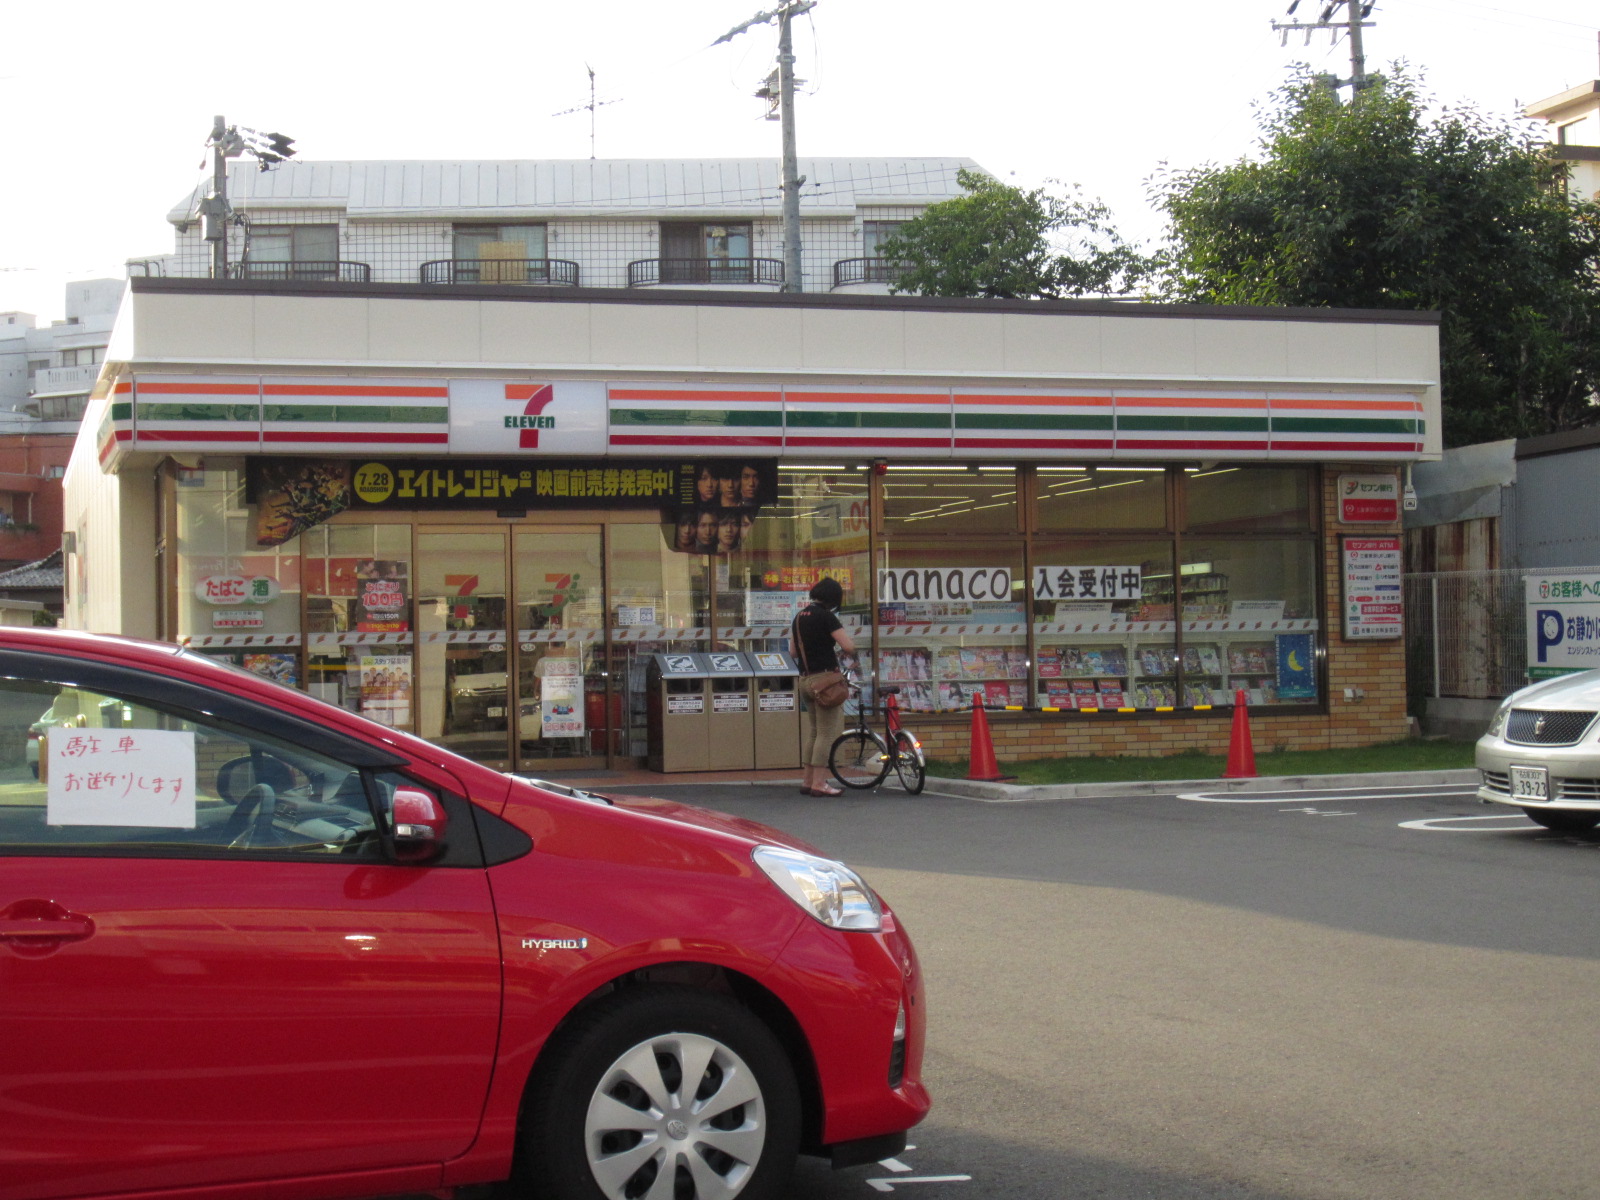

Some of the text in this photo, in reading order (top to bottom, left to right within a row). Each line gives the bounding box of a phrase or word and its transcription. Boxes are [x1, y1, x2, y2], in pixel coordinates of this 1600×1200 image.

[505, 384, 553, 448] 7
[359, 473, 389, 486] 7.28
[206, 579, 269, 596] たばこ 酒
[878, 569, 1010, 600] nanaco
[1036, 567, 1140, 599] 入会受付中
[362, 592, 404, 607] 100円
[65, 772, 183, 805] お断りします
[522, 939, 577, 949] HYBRID
